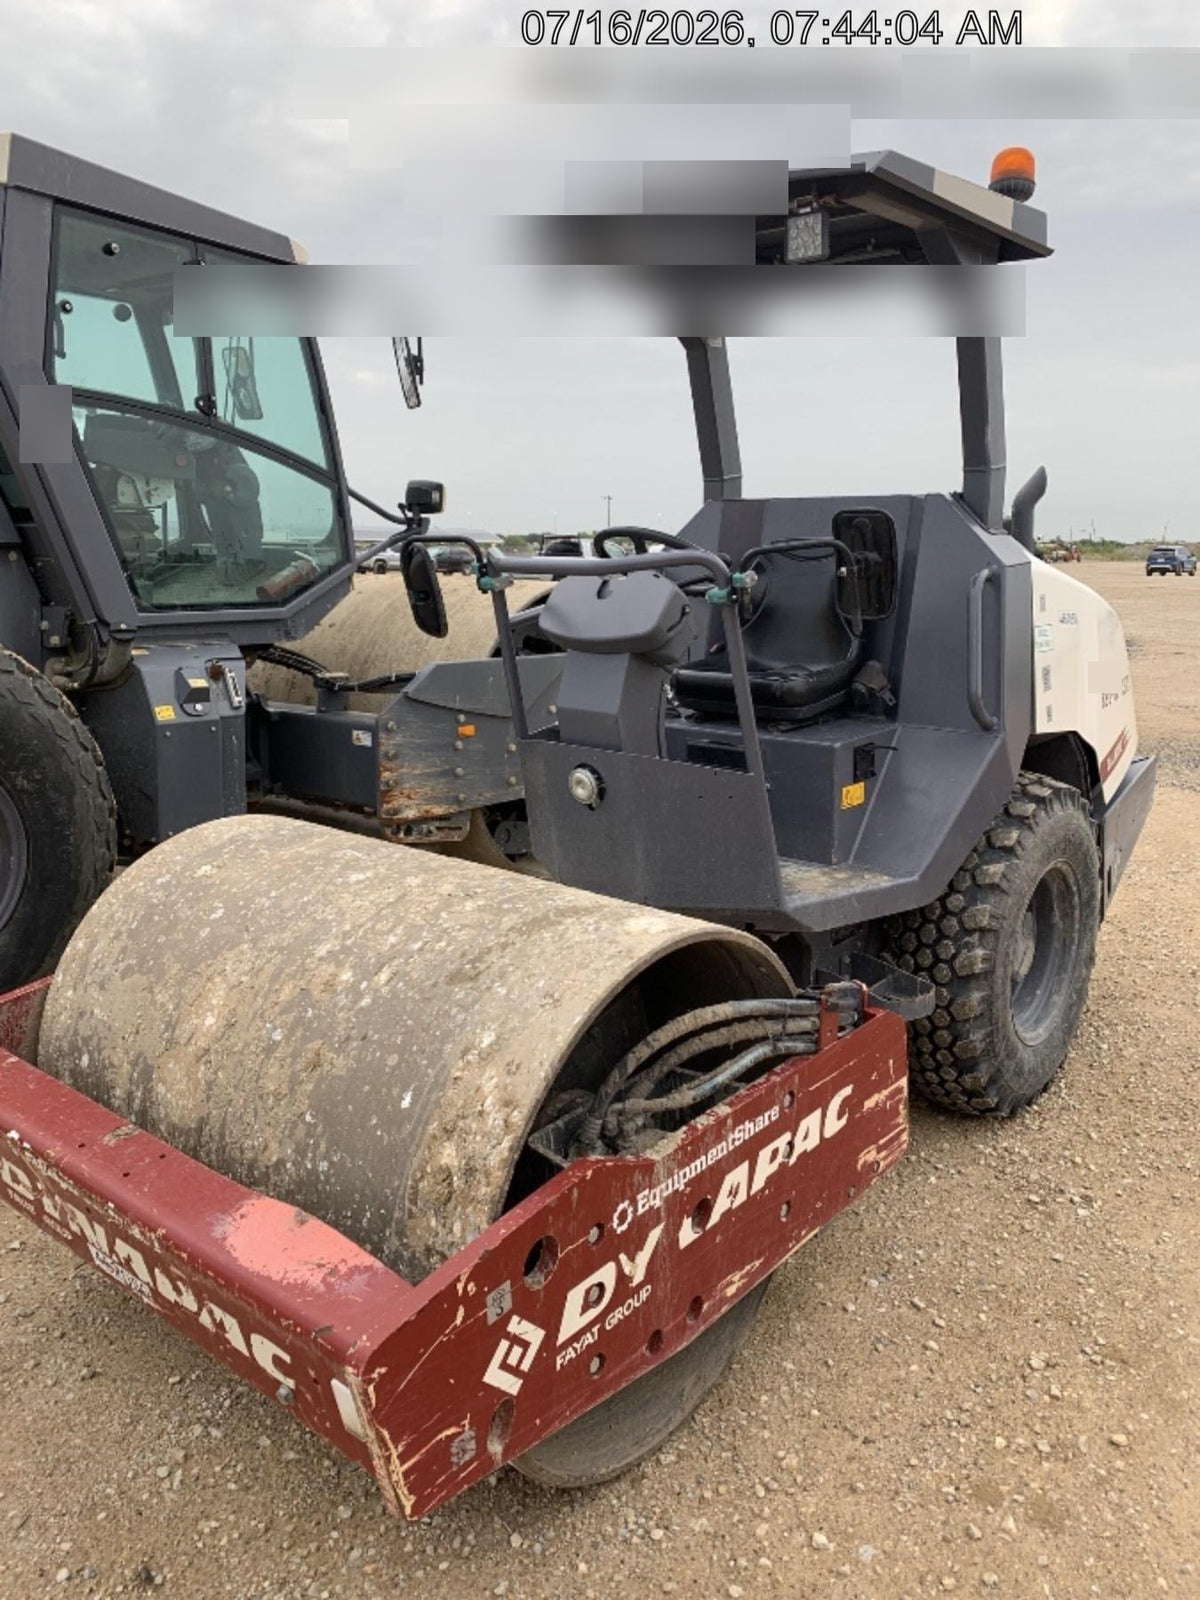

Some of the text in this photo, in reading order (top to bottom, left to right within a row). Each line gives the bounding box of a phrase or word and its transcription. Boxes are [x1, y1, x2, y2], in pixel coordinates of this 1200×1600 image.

[556, 1084, 854, 1347] DYAPAC
[636, 1104, 780, 1216] EquipmentShare
[556, 1285, 652, 1372] FAYAT GROUP
